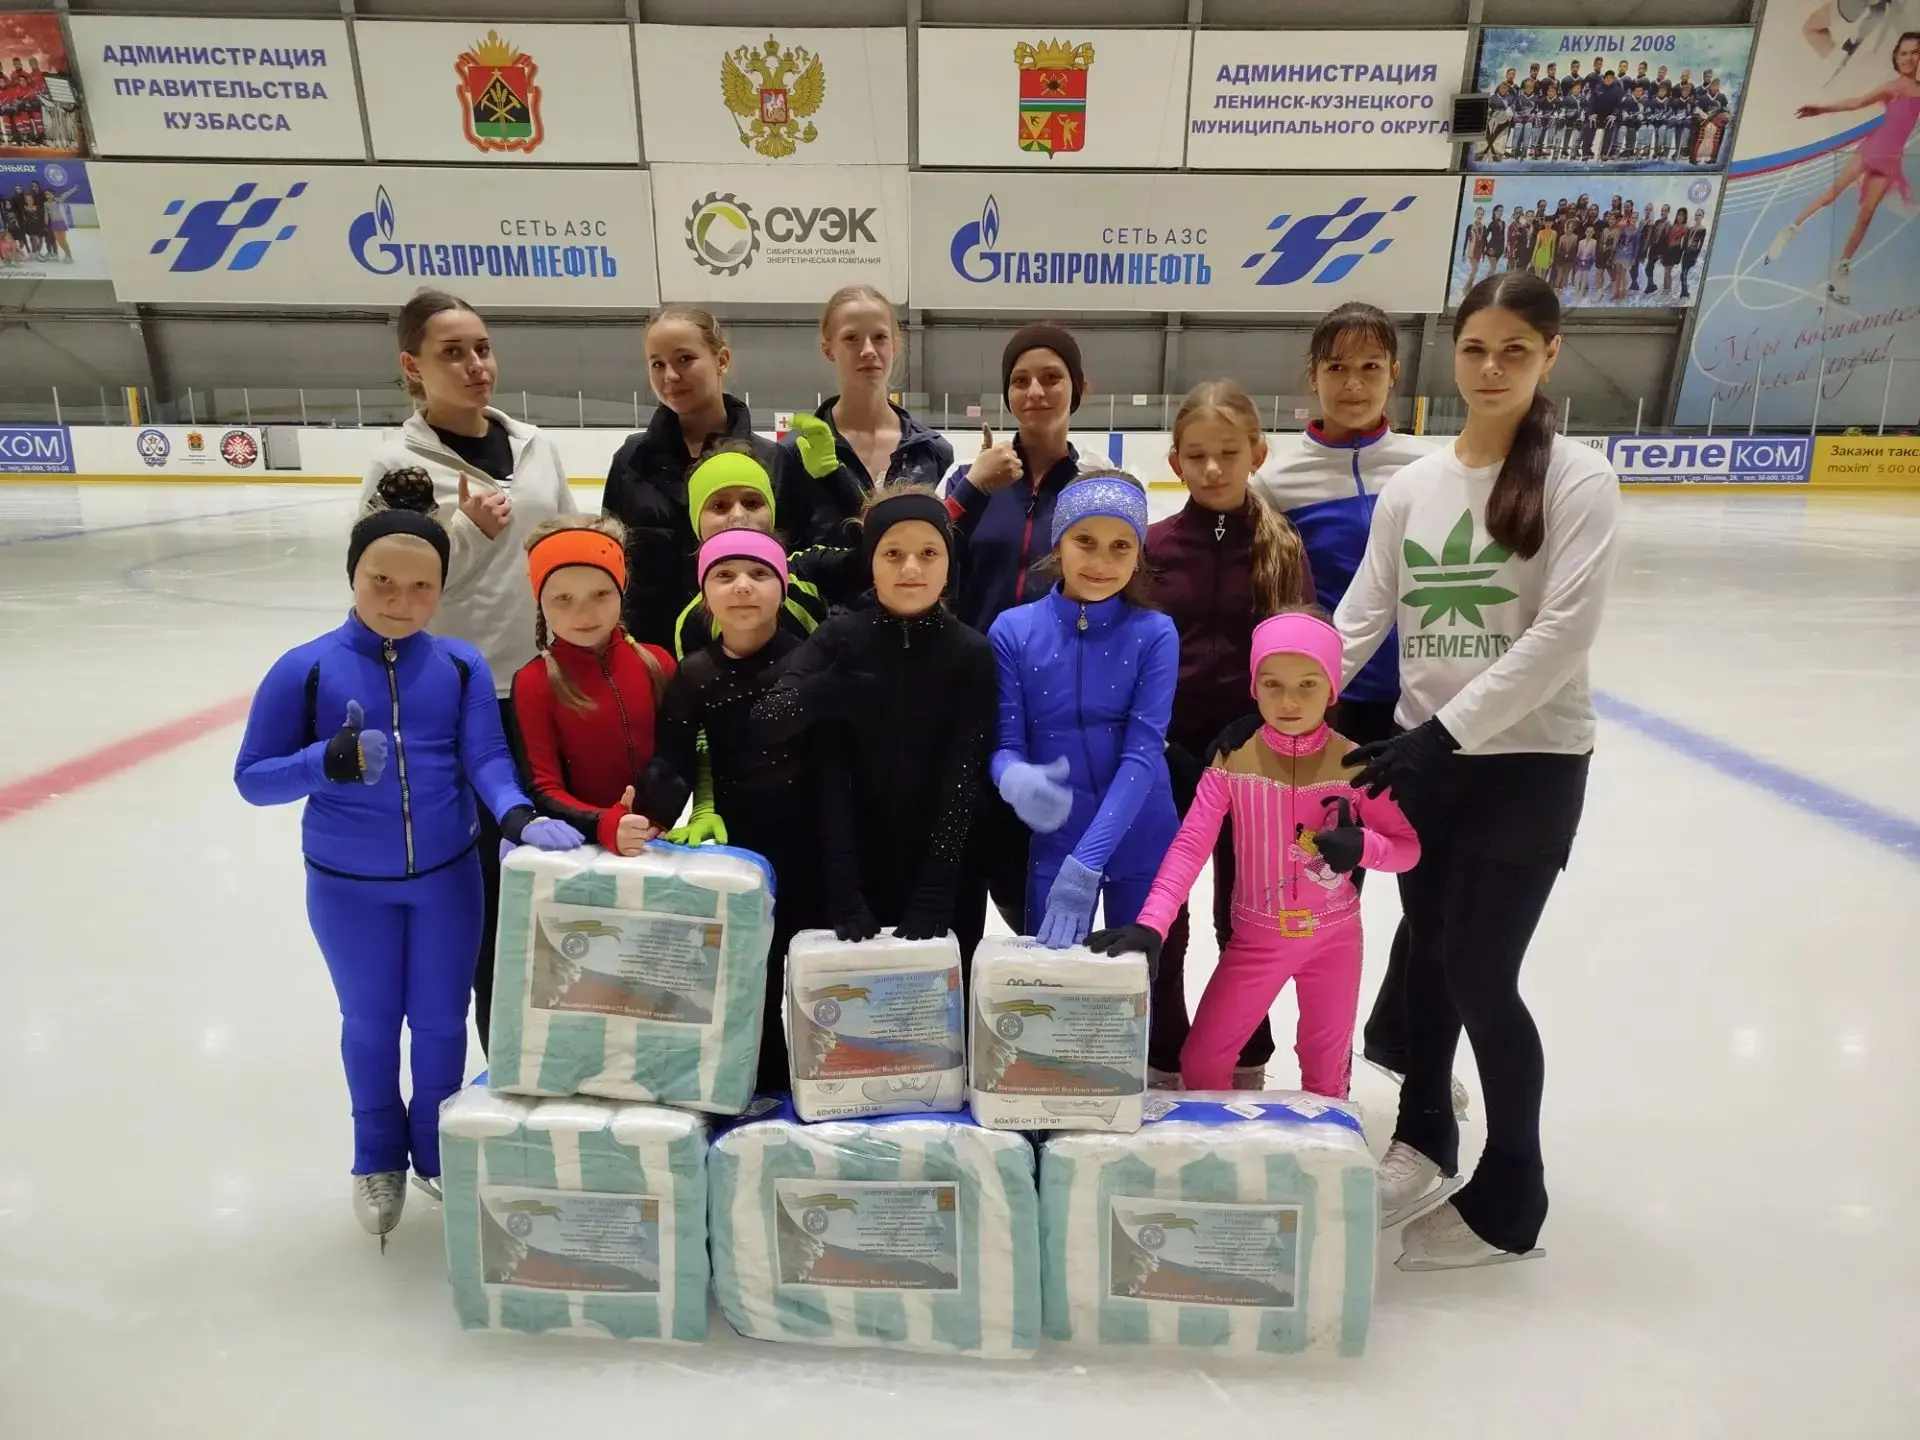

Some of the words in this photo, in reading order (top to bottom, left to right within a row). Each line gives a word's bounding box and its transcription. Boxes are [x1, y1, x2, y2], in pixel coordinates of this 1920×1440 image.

[1559, 35, 1625, 52] АКУЛЫ
[1630, 35, 1676, 51] 2008
[103, 44, 327, 69] АДМИНИСТРАЦИЯ
[1216, 64, 1438, 85] АДМИНИСТРАЦИЯ
[114, 78, 328, 100] ПРАВИТЕЛЬСТВА
[1213, 94, 1434, 111] ЛЕНИНСК-КУЗНЕЦКОГО
[163, 111, 292, 131] КУЗБАССА
[1191, 119, 1375, 136] МУНИЦИПАЛЬНОГО
[1380, 119, 1450, 134] ОКРУГА
[500, 219, 557, 236] СЕТЬ
[564, 220, 607, 237] АЗС
[765, 206, 878, 243] СУЭК
[1102, 227, 1158, 244] СЕТЬ
[1165, 228, 1208, 245] АЗС
[403, 243, 617, 278] ГАЗПРОМНЕФТЬ
[766, 256, 836, 264] ЭНЕРГЕТИЧЕСКАЯ
[838, 257, 881, 265] КОМПАНИЯ
[815, 248, 855, 256] УГОЛЬНАЯ
[1003, 251, 1212, 285] ГАЗПРОМНЕФТЬ
[1830, 445, 1884, 457] Закажи
[1888, 448, 1920, 457] такс
